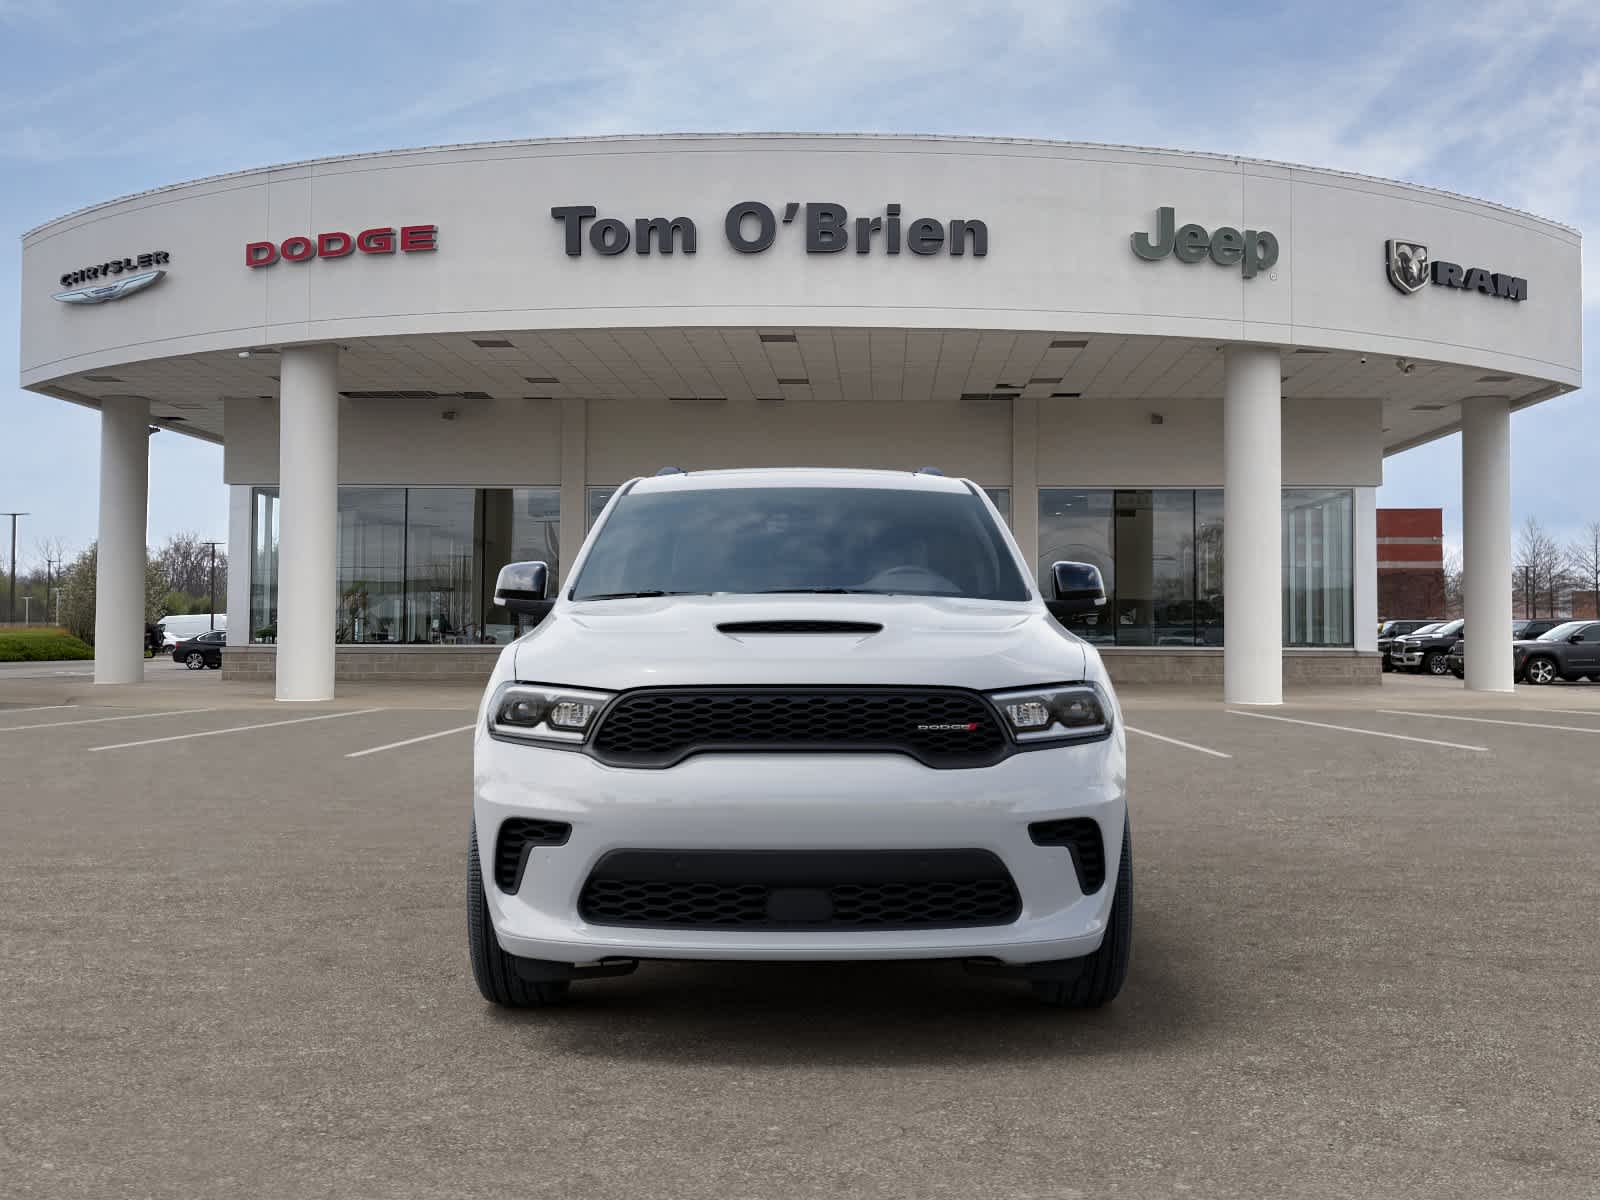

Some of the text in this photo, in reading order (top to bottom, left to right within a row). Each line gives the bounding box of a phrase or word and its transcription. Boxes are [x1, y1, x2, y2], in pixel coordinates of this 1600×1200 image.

[245, 224, 438, 269] DODGE
[551, 201, 989, 257] Tom O'Brien
[1130, 206, 1280, 279] Jeep
[60, 250, 170, 287] CHRYSLER
[1430, 260, 1528, 302] RAM
